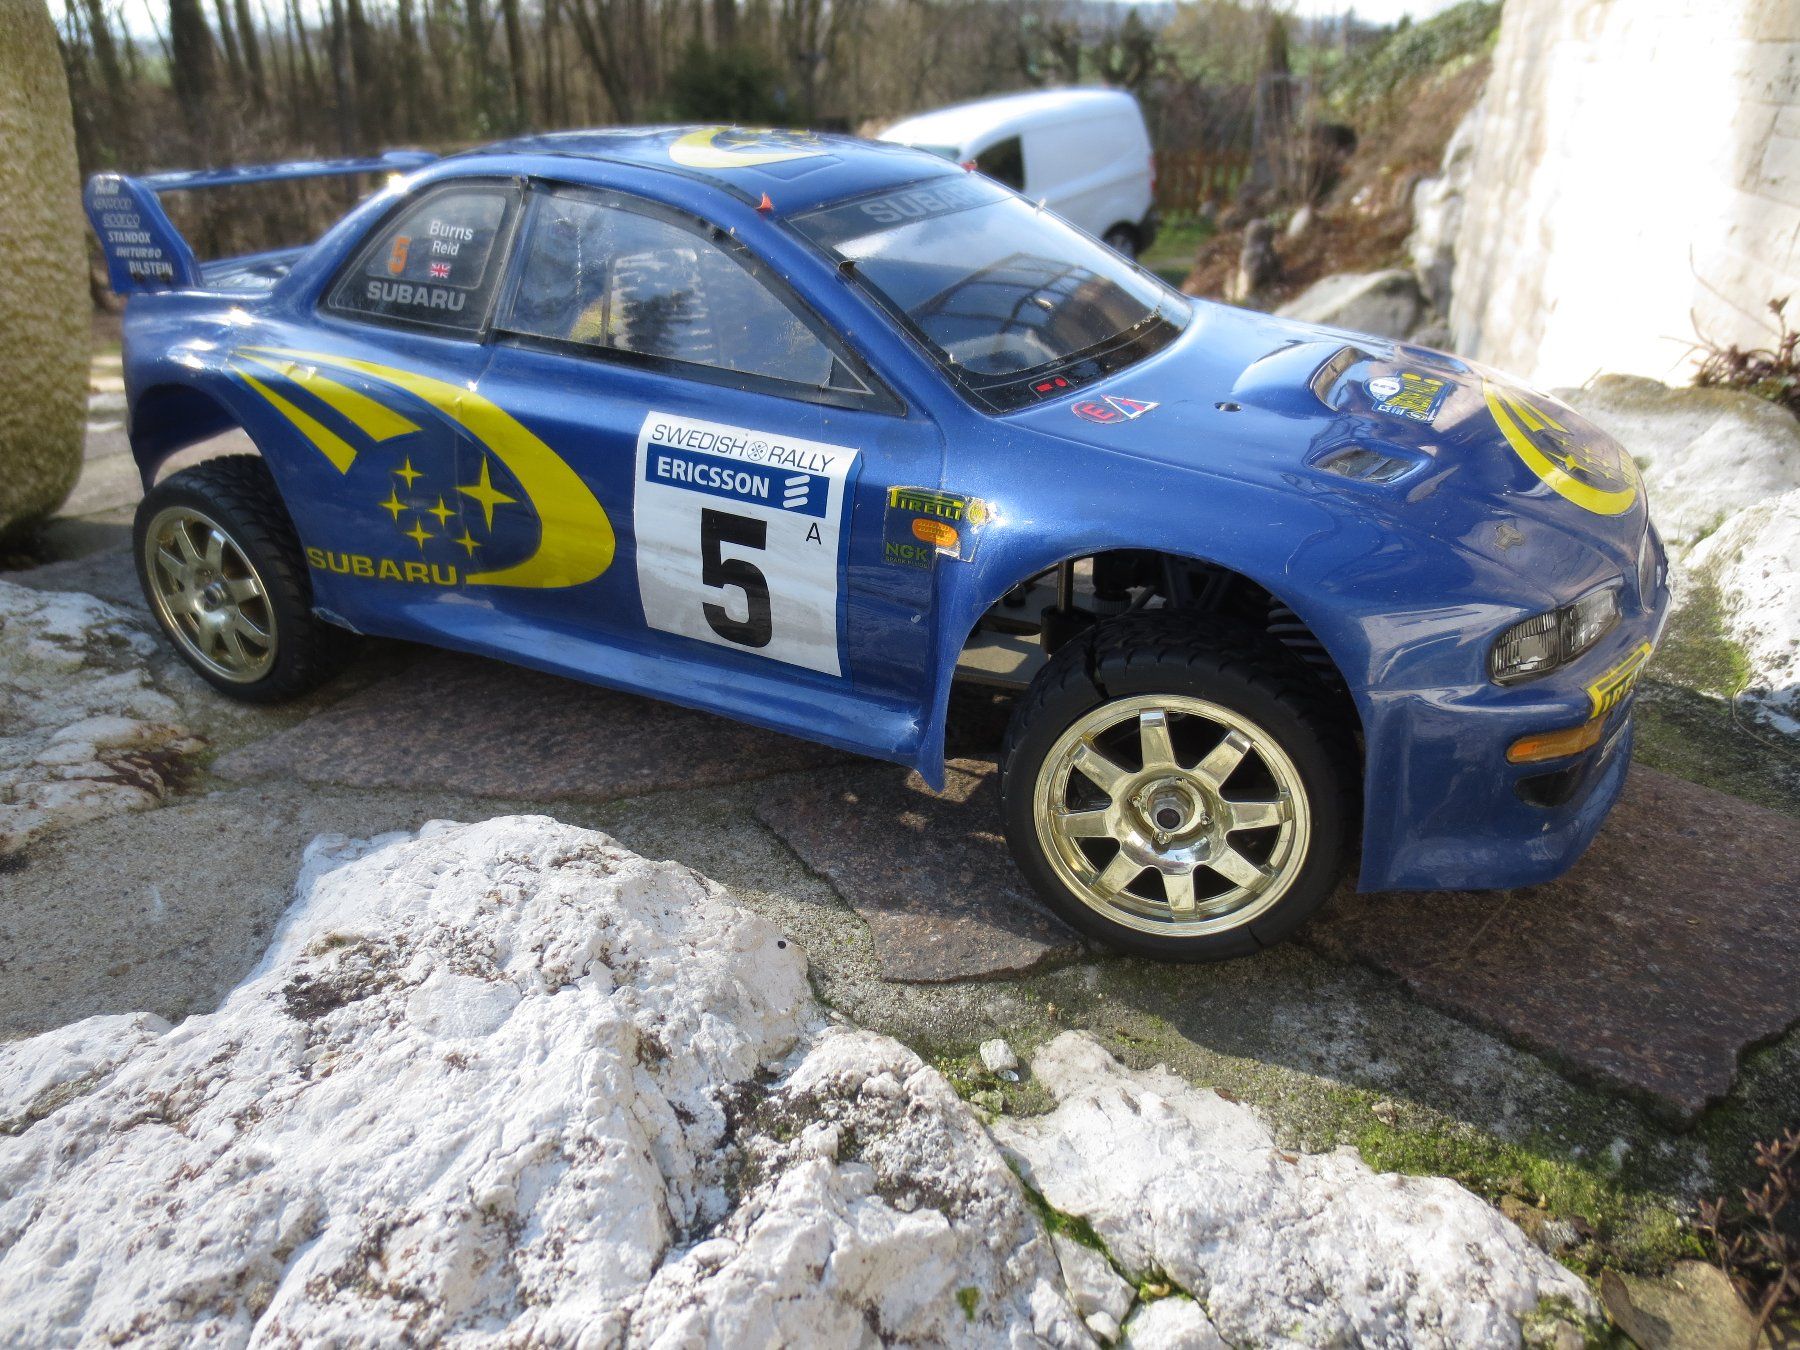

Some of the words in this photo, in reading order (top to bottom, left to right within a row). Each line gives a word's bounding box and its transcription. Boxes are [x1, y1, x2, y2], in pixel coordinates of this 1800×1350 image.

[108, 231, 151, 244] STANDOX
[429, 220, 474, 241] Burns
[388, 235, 411, 275] 5
[432, 240, 459, 256] Reid
[367, 281, 466, 311] SUBARU
[651, 424, 748, 457] SWEDISH
[767, 445, 835, 473] RALLY
[657, 456, 770, 499] ERICSSON
[890, 487, 965, 520] PIRELLI
[805, 522, 822, 545] A
[306, 547, 458, 586] SUBARU
[886, 542, 927, 561] NGK
[701, 507, 773, 649] 5
